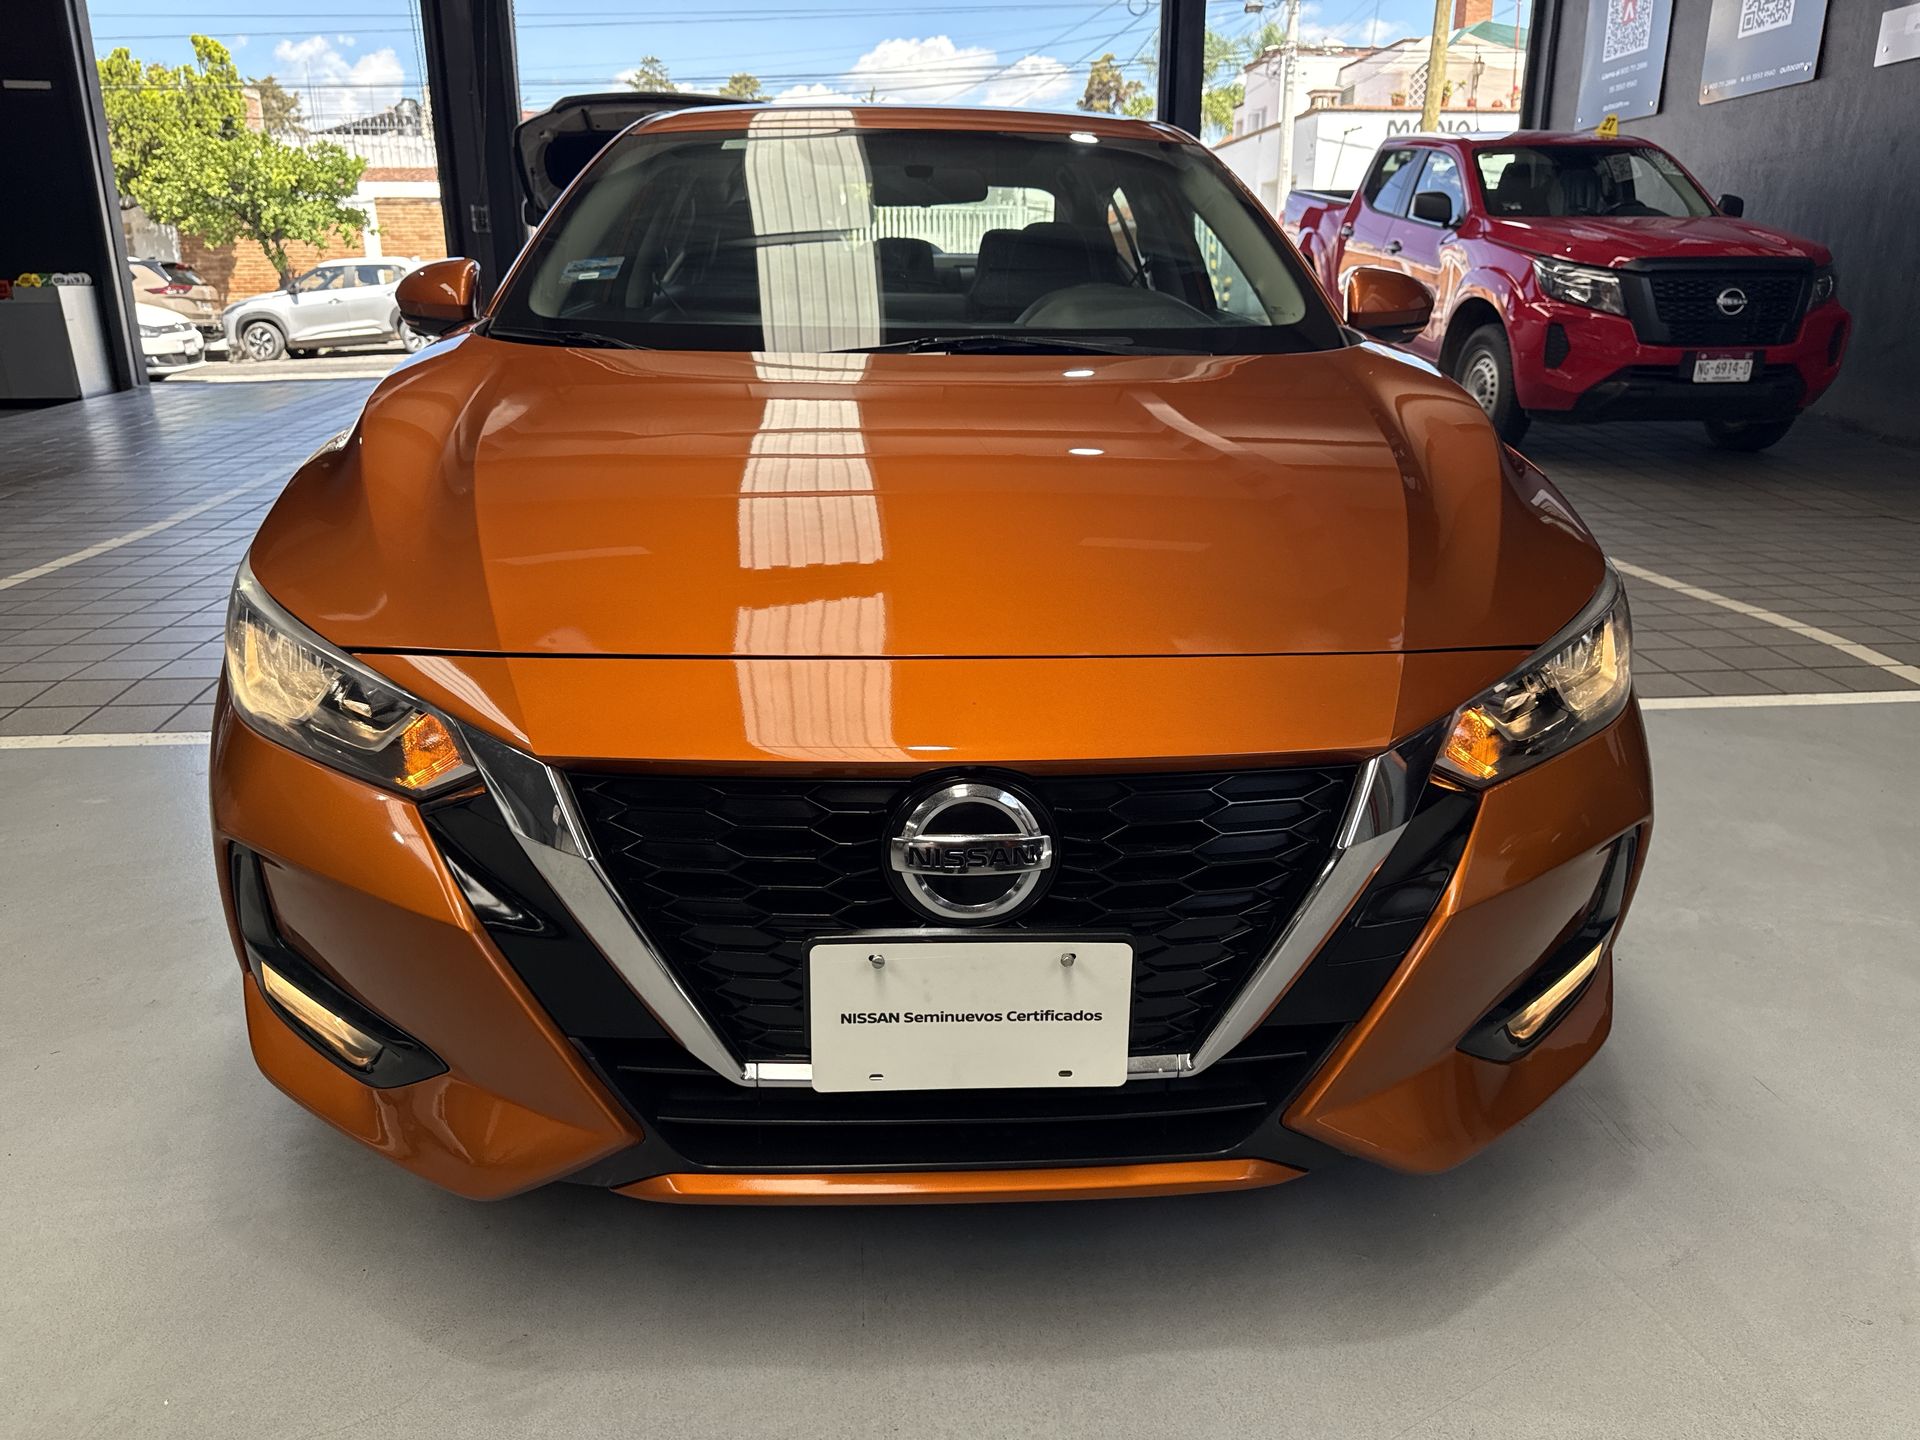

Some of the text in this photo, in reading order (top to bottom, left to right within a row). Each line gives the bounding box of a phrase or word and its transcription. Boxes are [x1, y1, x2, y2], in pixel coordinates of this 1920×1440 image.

[907, 845, 1038, 868] NISSAN
[840, 1009, 1103, 1024] NISSAN Seminuevos Certificados
